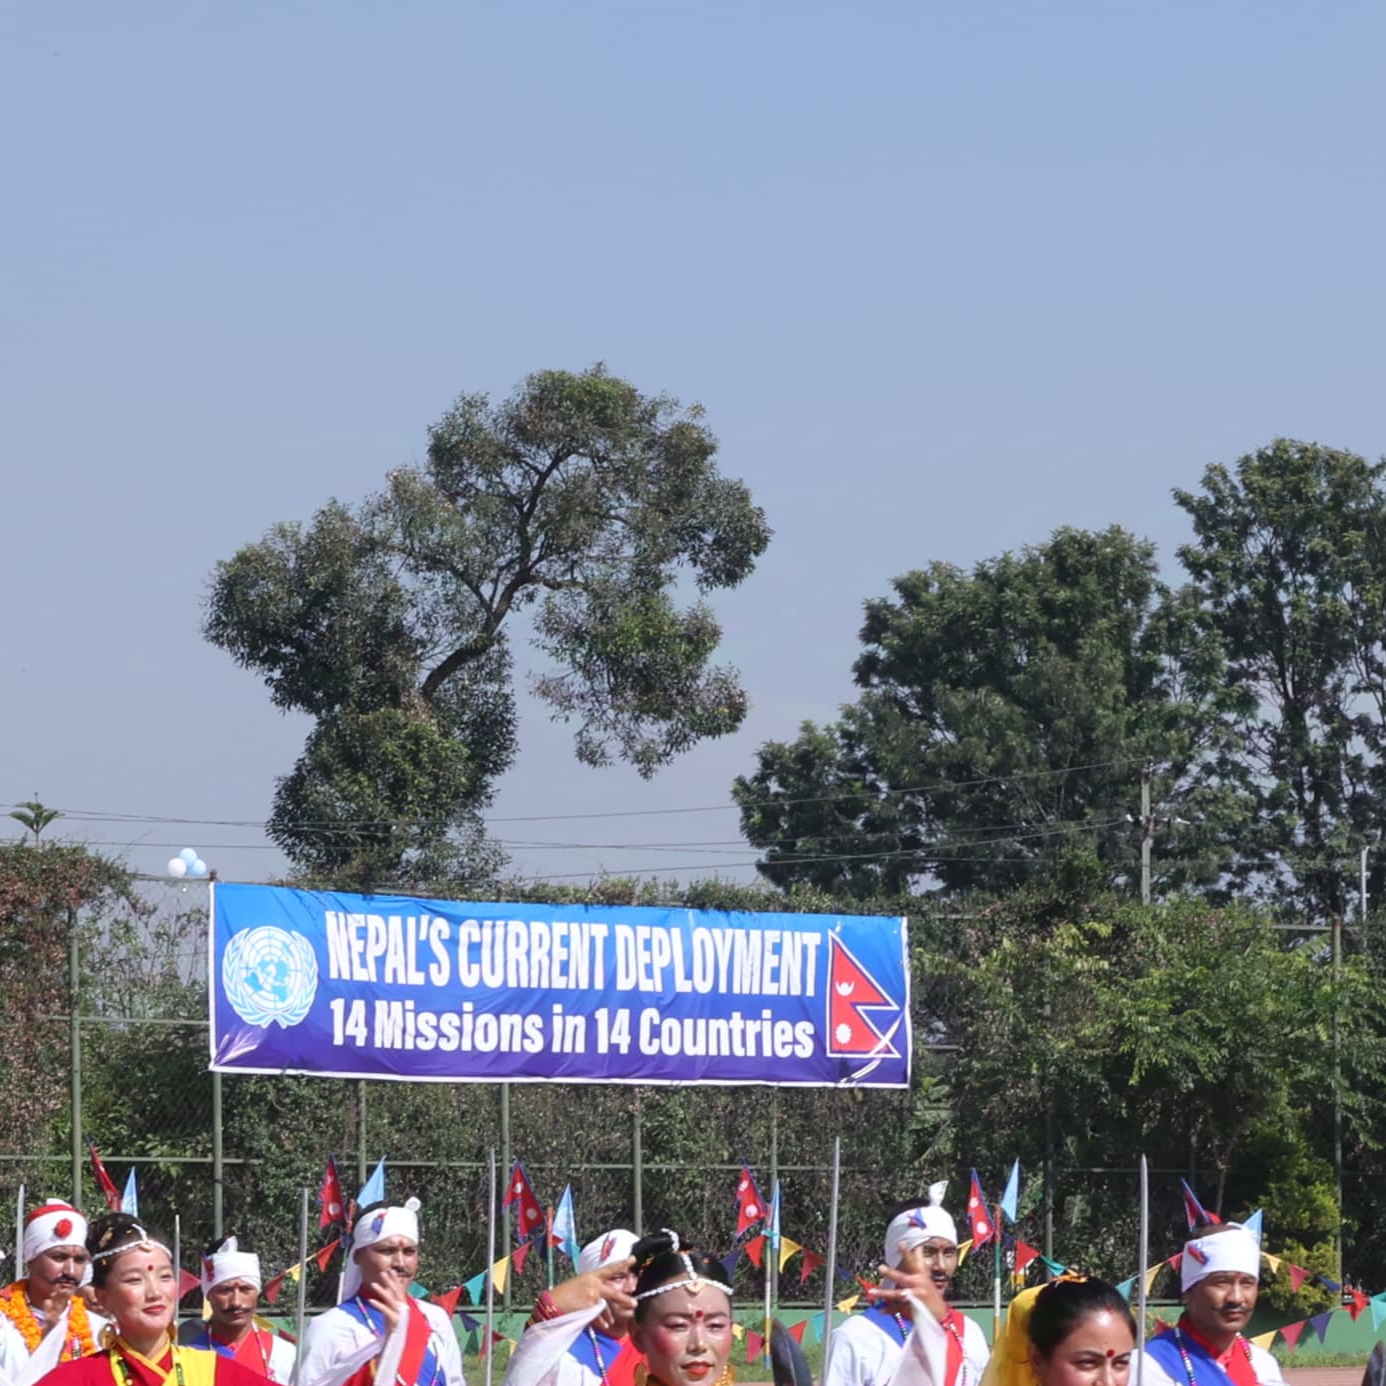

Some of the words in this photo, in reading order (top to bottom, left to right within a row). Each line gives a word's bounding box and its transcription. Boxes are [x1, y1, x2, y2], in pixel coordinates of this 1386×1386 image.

[324, 911, 451, 987] NEPAL'S
[458, 919, 609, 990] CURRENT
[614, 924, 822, 997] DEPLOYMENT
[329, 998, 368, 1047] 14
[374, 1000, 545, 1054] Missions
[552, 1003, 586, 1054] in
[594, 1007, 631, 1055] 14
[639, 1007, 816, 1059] Countries
